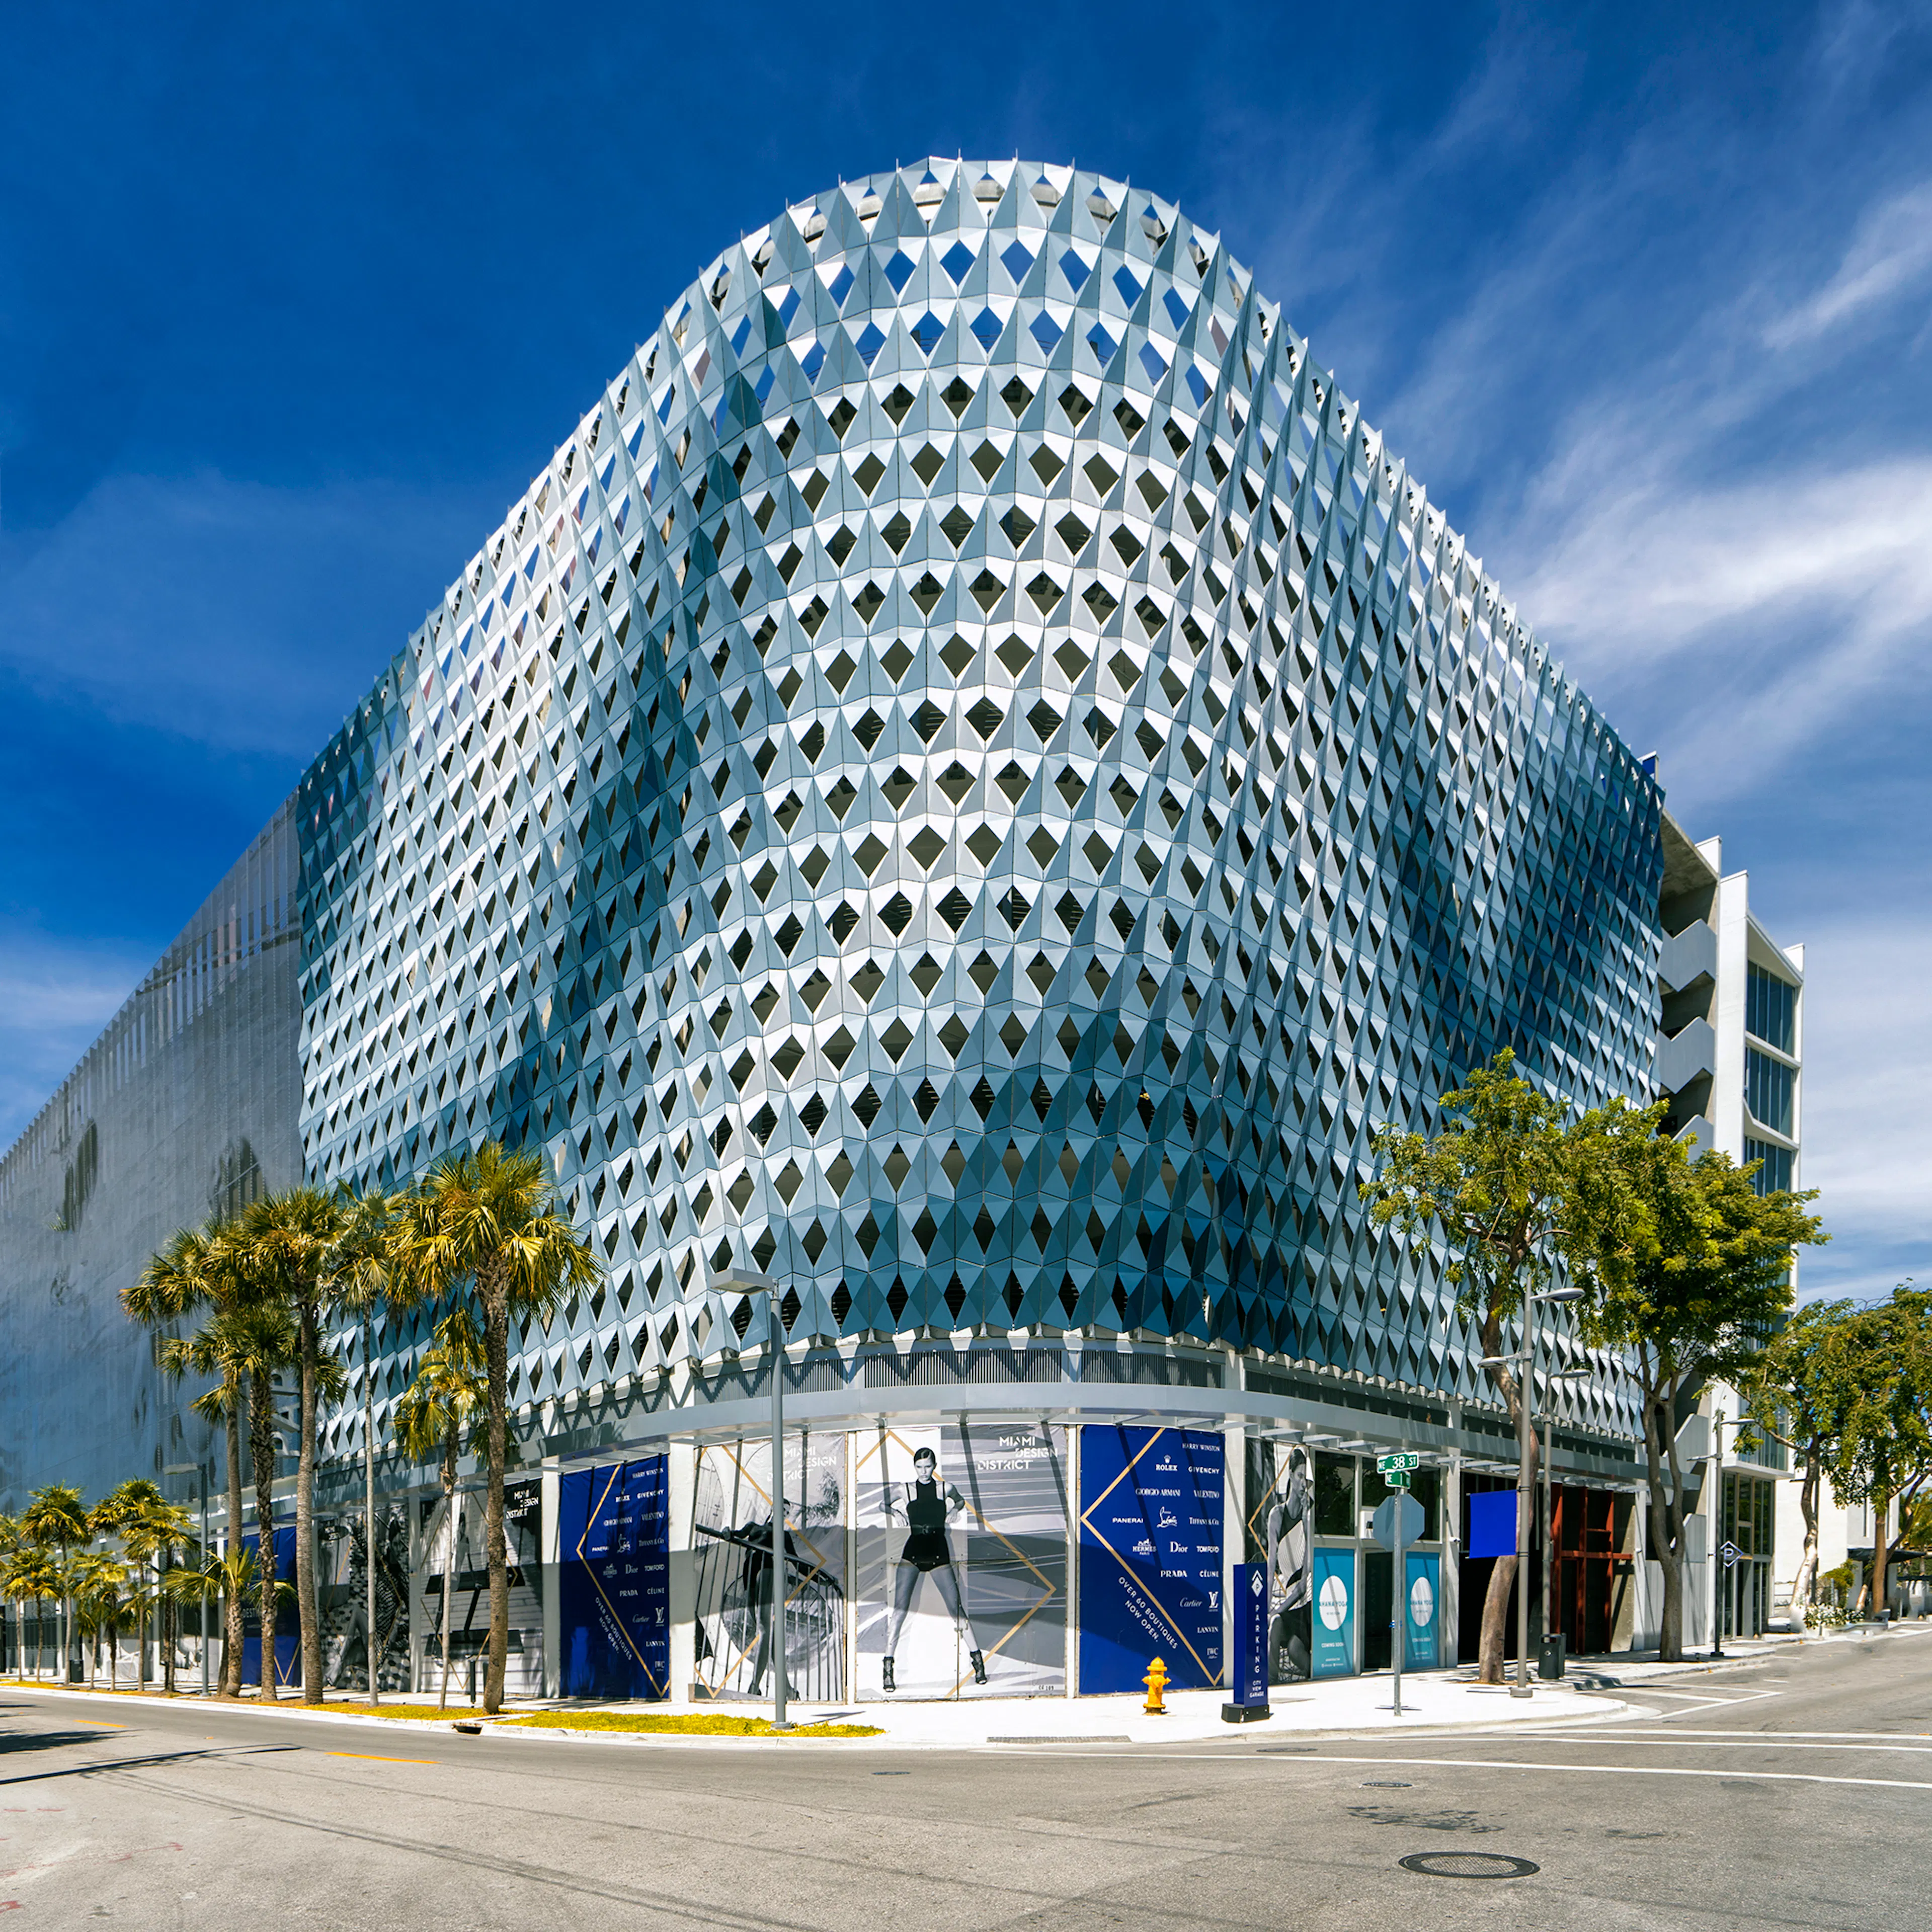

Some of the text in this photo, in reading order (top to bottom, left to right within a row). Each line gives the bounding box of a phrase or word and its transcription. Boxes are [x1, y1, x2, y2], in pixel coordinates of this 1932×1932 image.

[999, 1436, 1035, 1446] MIAMI
[785, 1446, 816, 1458] MIAMI
[1015, 1447, 1058, 1458] DESIGN
[798, 1457, 836, 1468] DESIGN
[978, 1460, 1033, 1470] DISTRICT
[1379, 1456, 1416, 1470] NE 38 ST
[767, 1469, 814, 1482] DTRICT
[1188, 1466, 1220, 1474] GIVENCHY
[1170, 1541, 1188, 1553] Dior
[1199, 1569, 1219, 1577] CÉLINE
[1180, 1597, 1203, 1607] Cartier
[1118, 1577, 1178, 1649] OVER 60 BOUTIQUES
[1124, 1600, 1159, 1642] NOW OPEN.
[610, 1623, 632, 1660] BOUTIQUES
